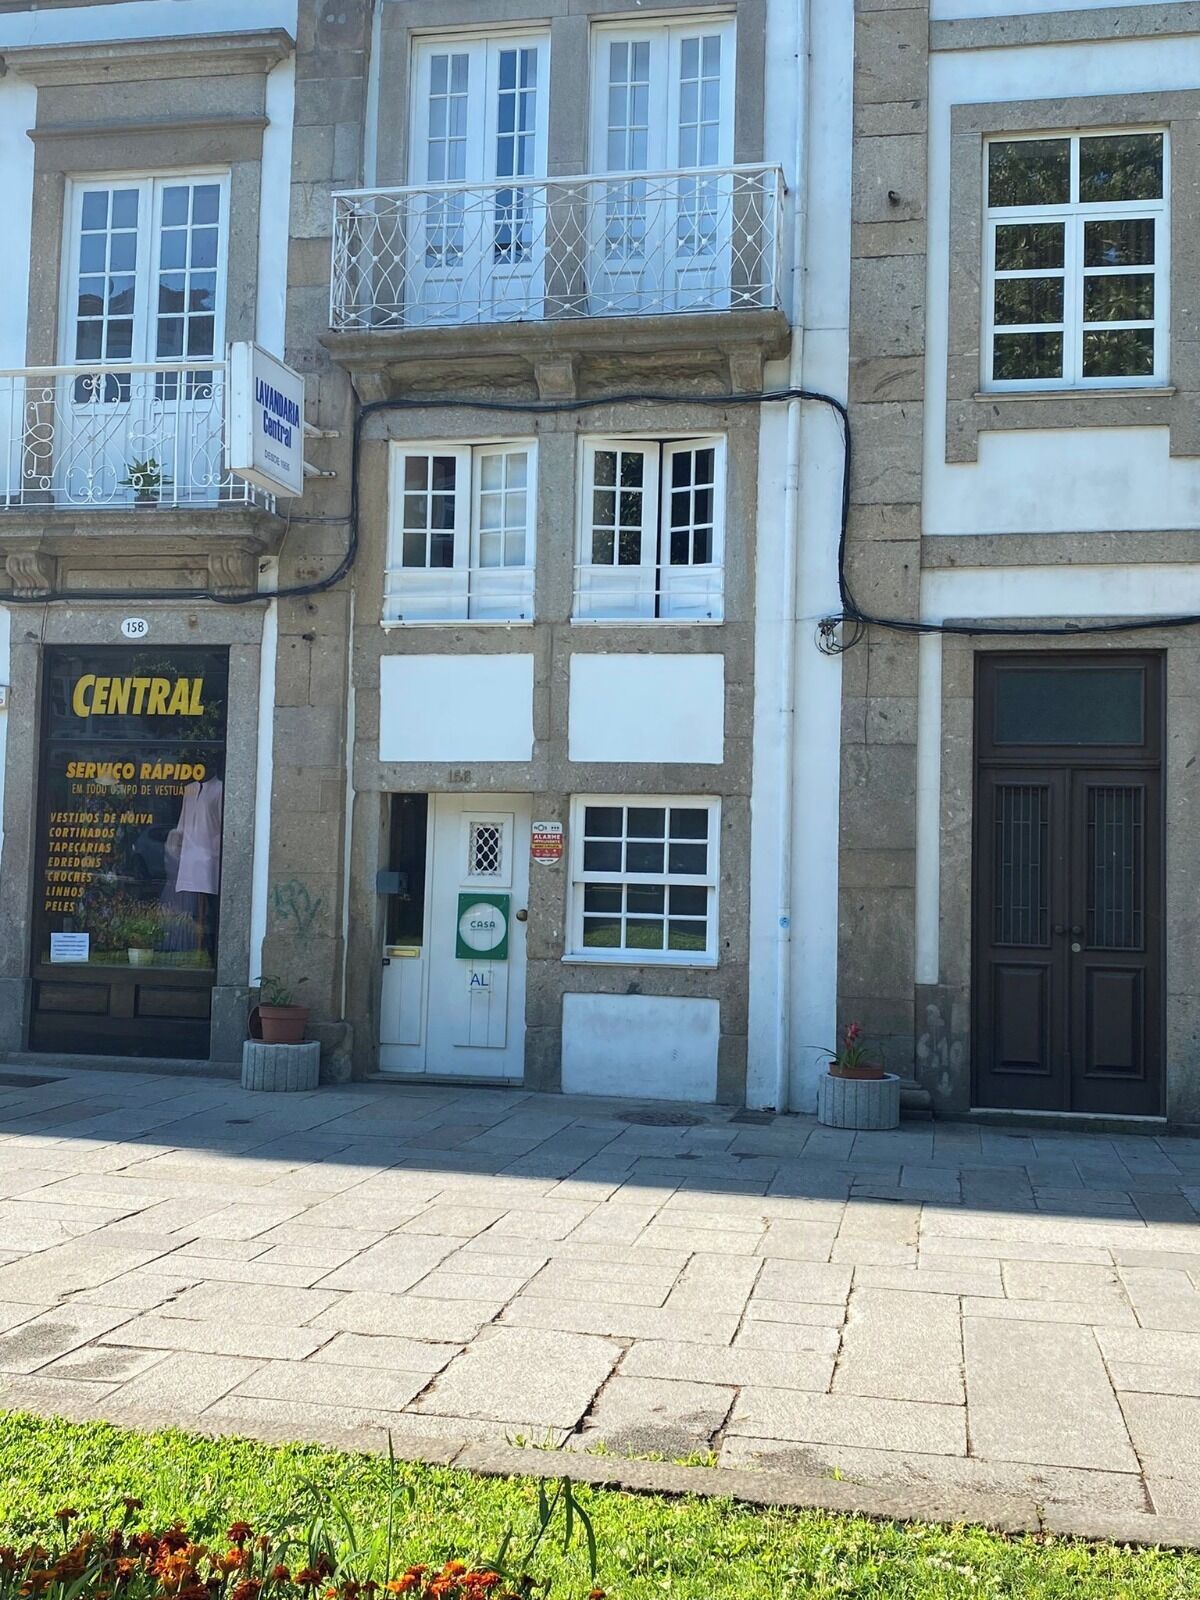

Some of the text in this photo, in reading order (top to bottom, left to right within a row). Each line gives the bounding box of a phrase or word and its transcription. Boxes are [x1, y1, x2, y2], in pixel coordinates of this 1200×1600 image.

[256, 376, 299, 429] LAVANDARIA
[263, 410, 292, 449] Central
[127, 621, 145, 633] 158
[72, 673, 205, 718] CENTRAL
[65, 757, 206, 781] SERVIÇO RÁPIDO
[86, 783, 107, 795] TODO
[141, 784, 152, 796] DE
[50, 812, 154, 825] VESTIDOS DE NOIVA
[49, 827, 116, 838] CORTINADOS
[49, 842, 112, 855] TAPEÇARIAS
[46, 886, 86, 898] LINHOS
[44, 901, 76, 912] PELES
[470, 920, 496, 929] CASA
[469, 973, 490, 987] AL
